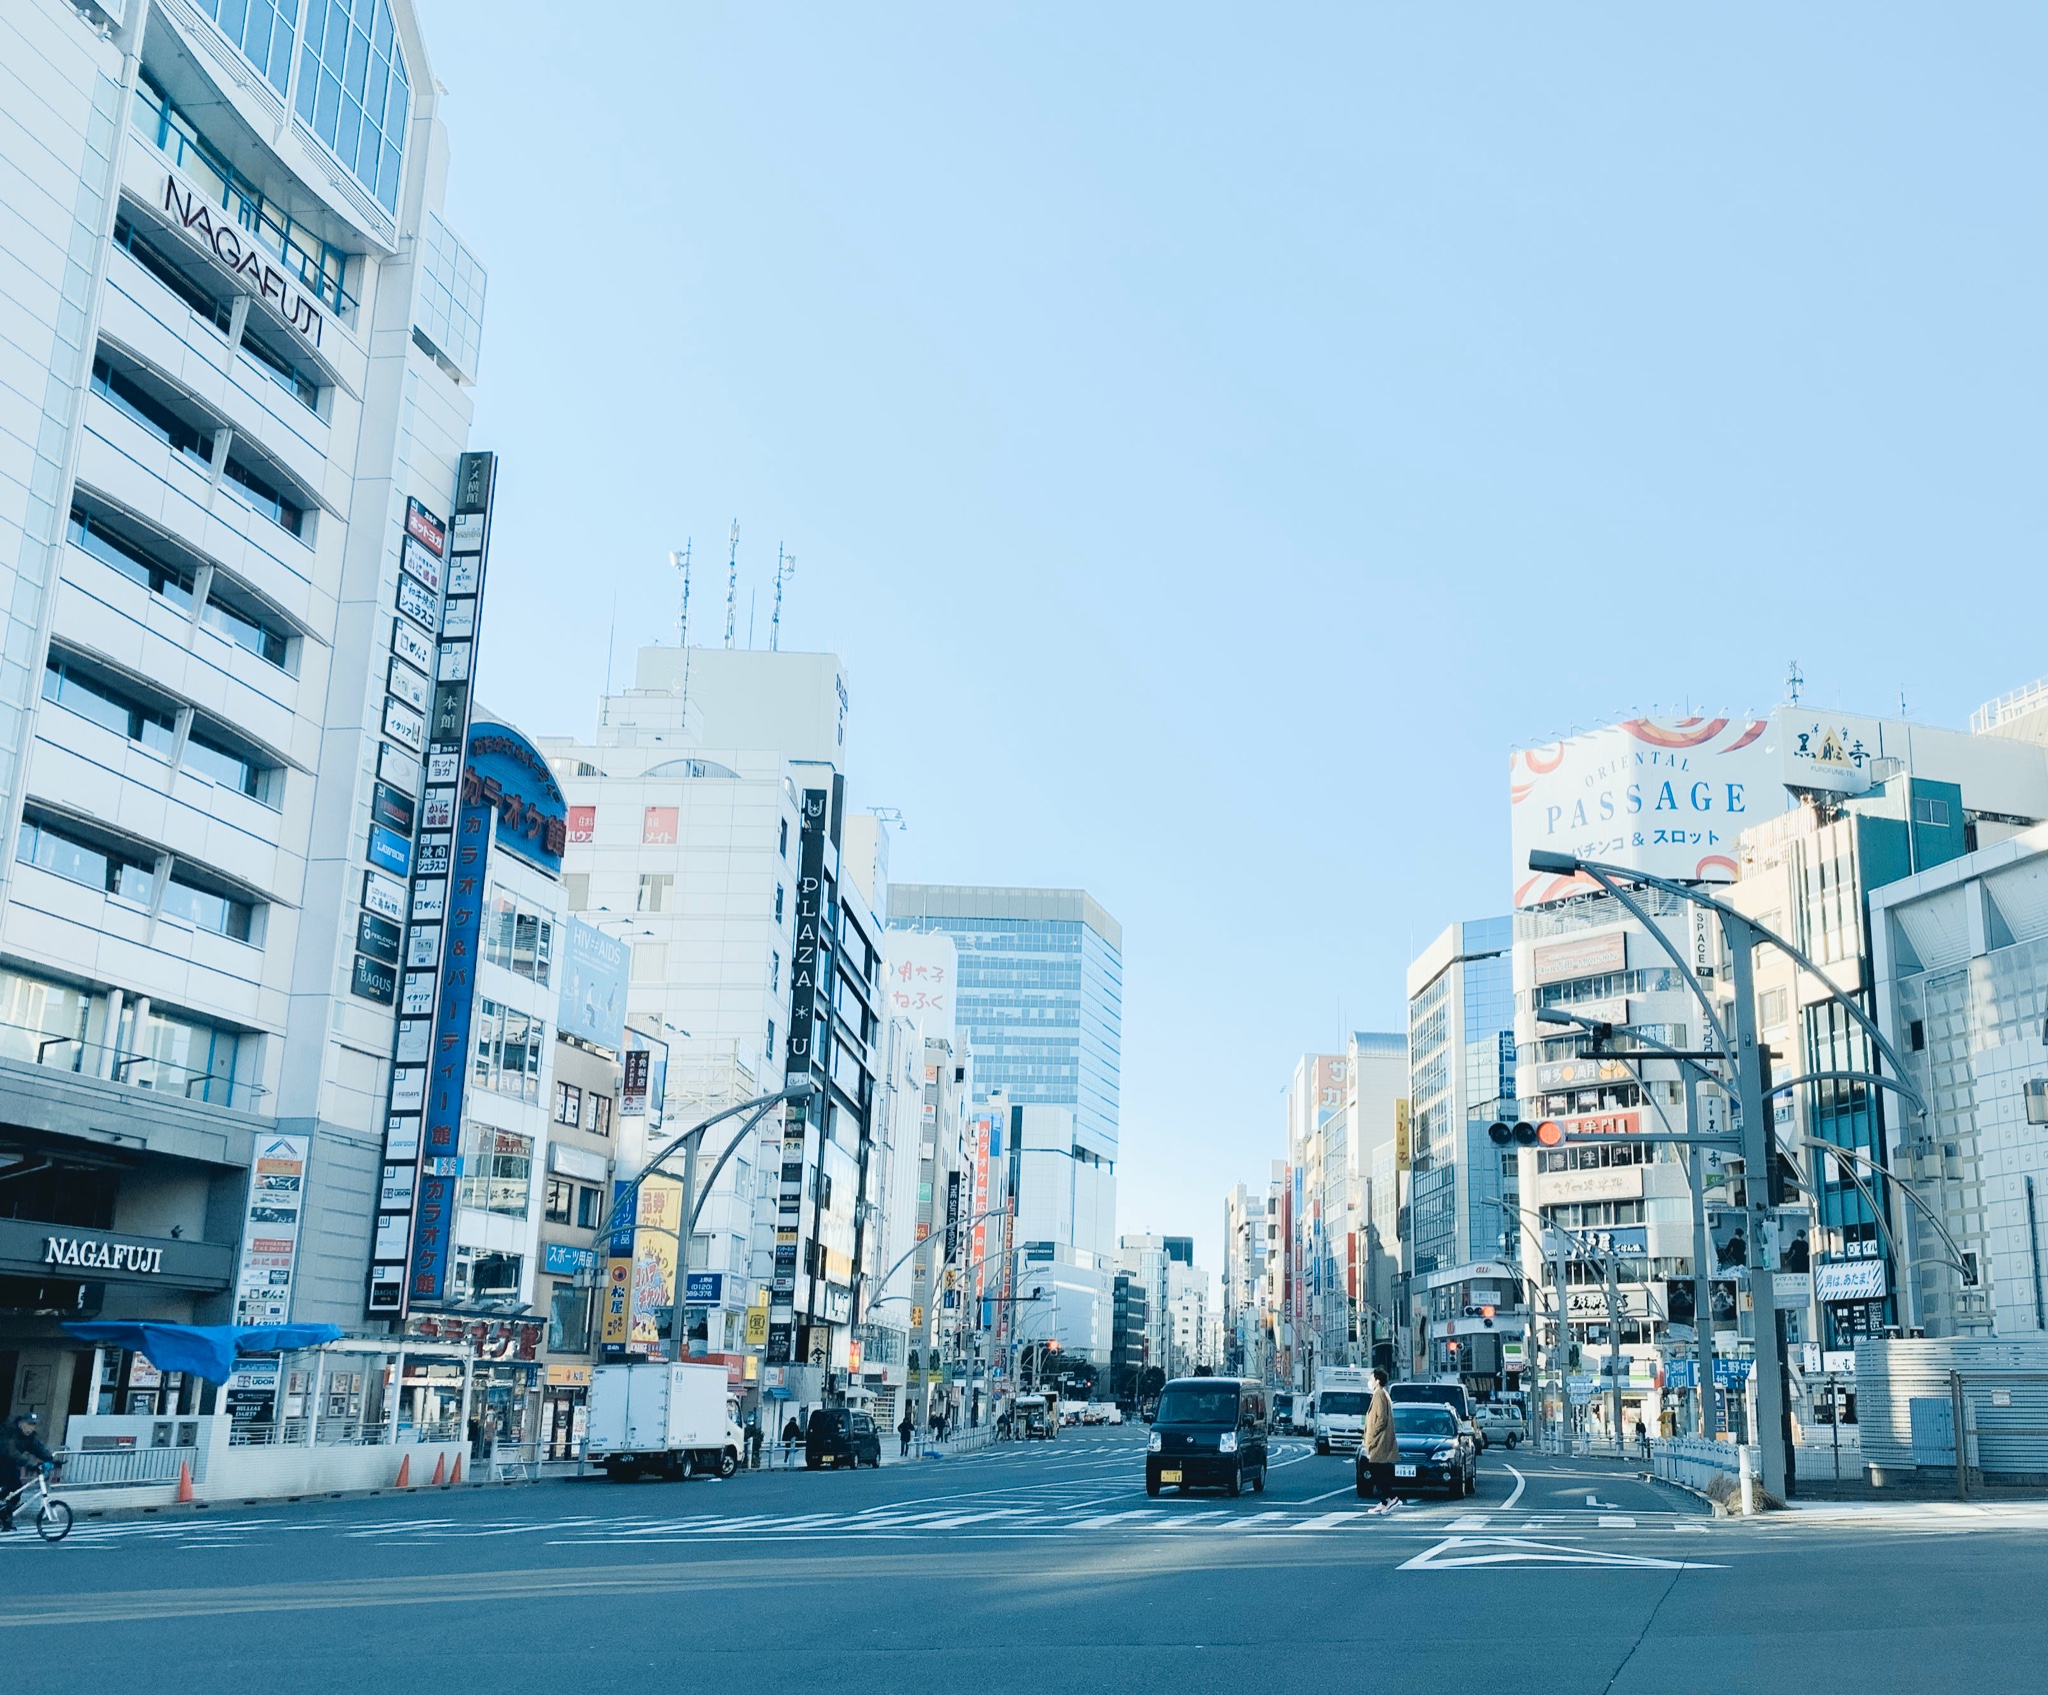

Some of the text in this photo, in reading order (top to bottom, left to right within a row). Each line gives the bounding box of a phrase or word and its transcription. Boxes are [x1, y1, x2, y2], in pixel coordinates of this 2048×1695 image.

[163, 174, 323, 348] NAGAFUJI
[466, 459, 481, 504] アメ横館
[410, 516, 442, 548] ホットヨガ
[402, 594, 434, 628] シュラスコ
[440, 696, 458, 728] 本館
[432, 760, 455, 768] ホット
[434, 768, 450, 776] ヨガ
[1584, 752, 1690, 788] ORIENTAL
[428, 803, 449, 814] かに
[462, 765, 567, 858] カラオケ館
[806, 798, 824, 818] U
[1546, 780, 1746, 835] PASSAGE
[646, 832, 672, 842] メイト
[1653, 830, 1720, 846] スロット
[376, 841, 405, 862] LAWSON
[418, 860, 446, 871] シュラスコ
[422, 846, 446, 859] 焼肉
[1696, 913, 1706, 964] SPACE
[792, 877, 820, 1055] PLAZA U
[360, 970, 392, 993] BAGUS
[406, 994, 430, 1002] イタリア
[636, 1058, 647, 1086] 免税店
[416, 1181, 444, 1294] カラオケ館
[45, 1236, 164, 1274] NAGAFUJI
[548, 1246, 594, 1268] スポーツ用品
[261, 1290, 284, 1299] がんこ
[610, 1284, 625, 1314] 松屋
